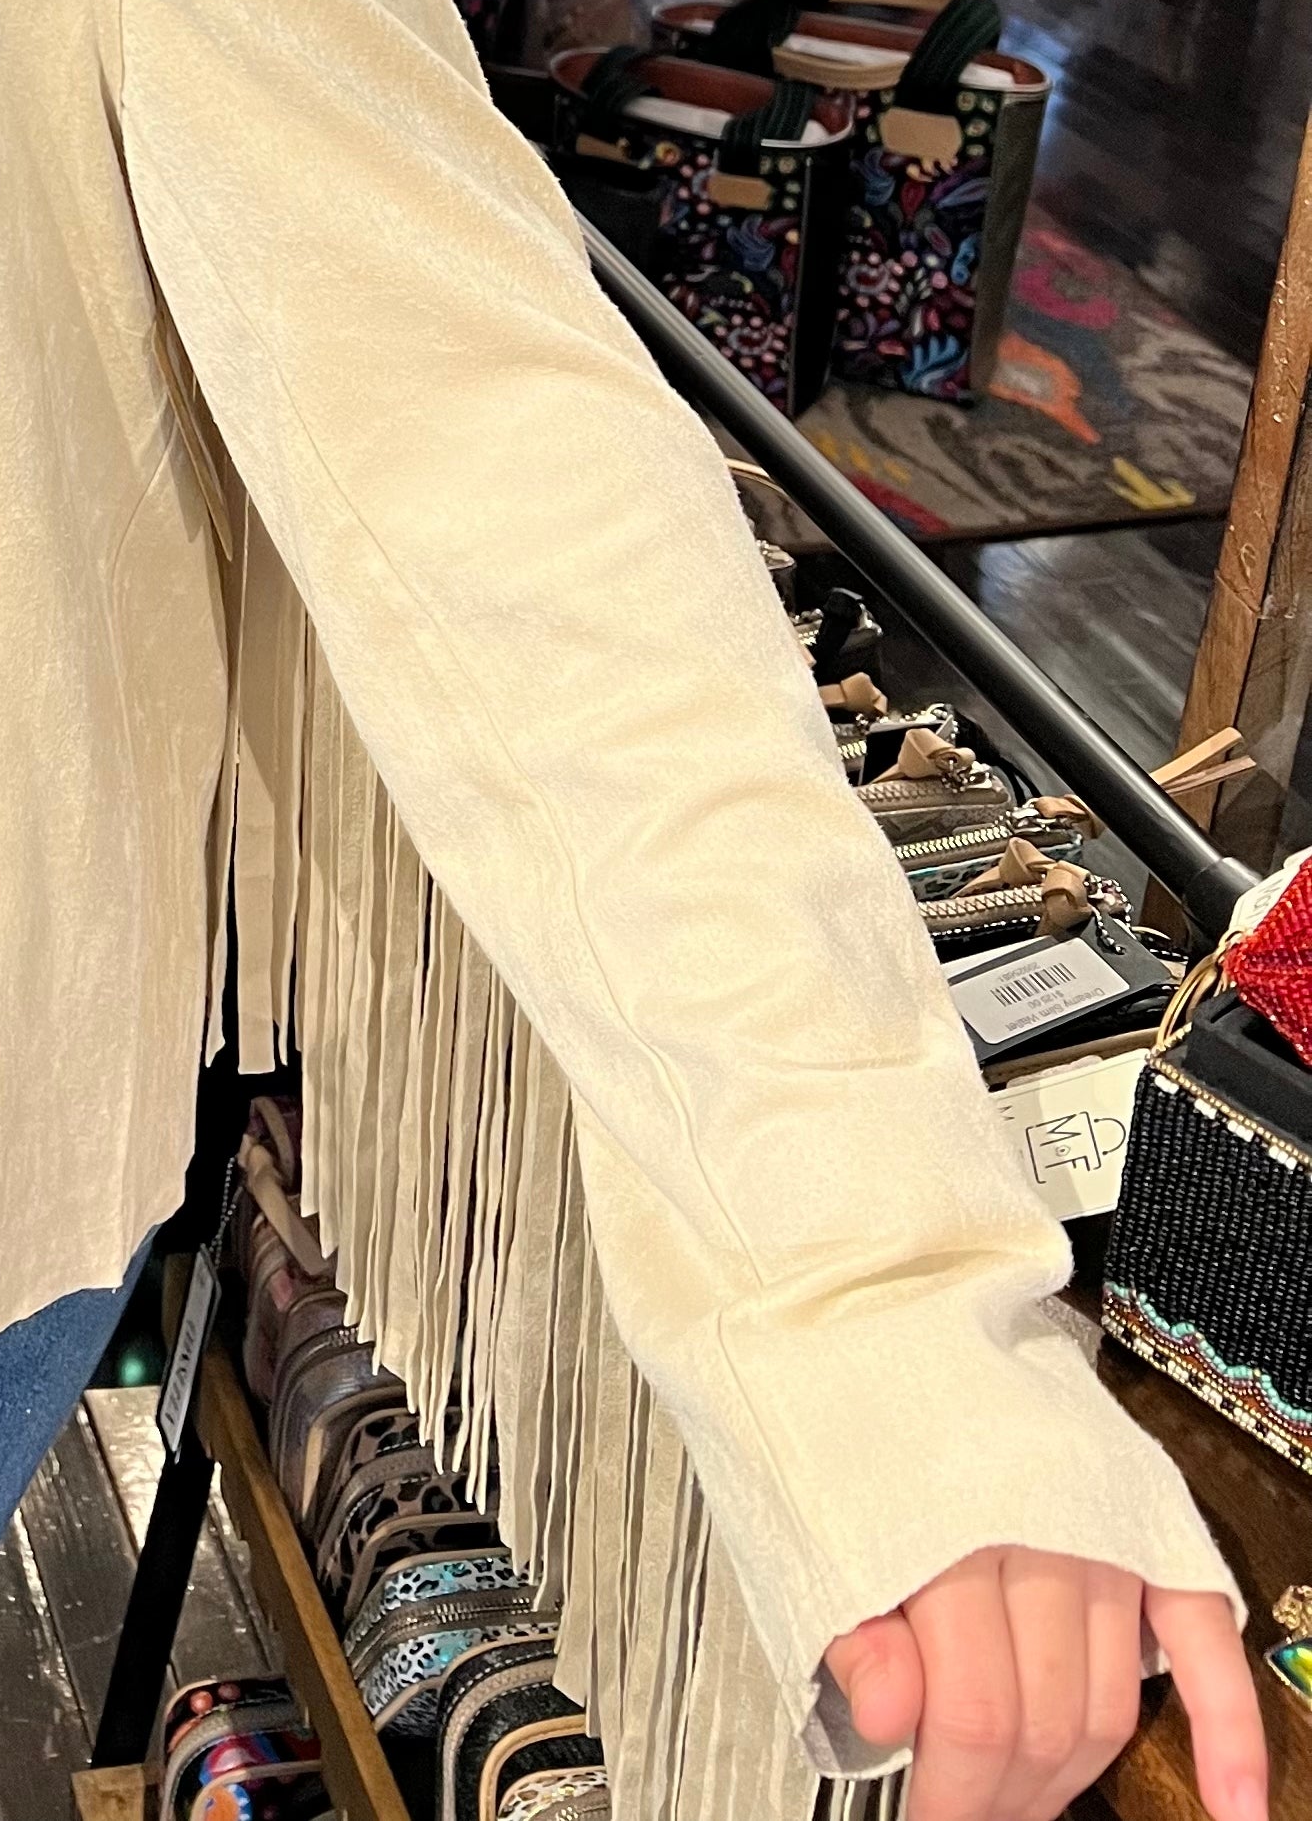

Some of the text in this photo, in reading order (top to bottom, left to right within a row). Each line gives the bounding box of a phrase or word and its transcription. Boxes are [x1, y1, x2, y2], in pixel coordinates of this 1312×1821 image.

[1005, 987, 1105, 1031] Dreamy Slim Wallet
